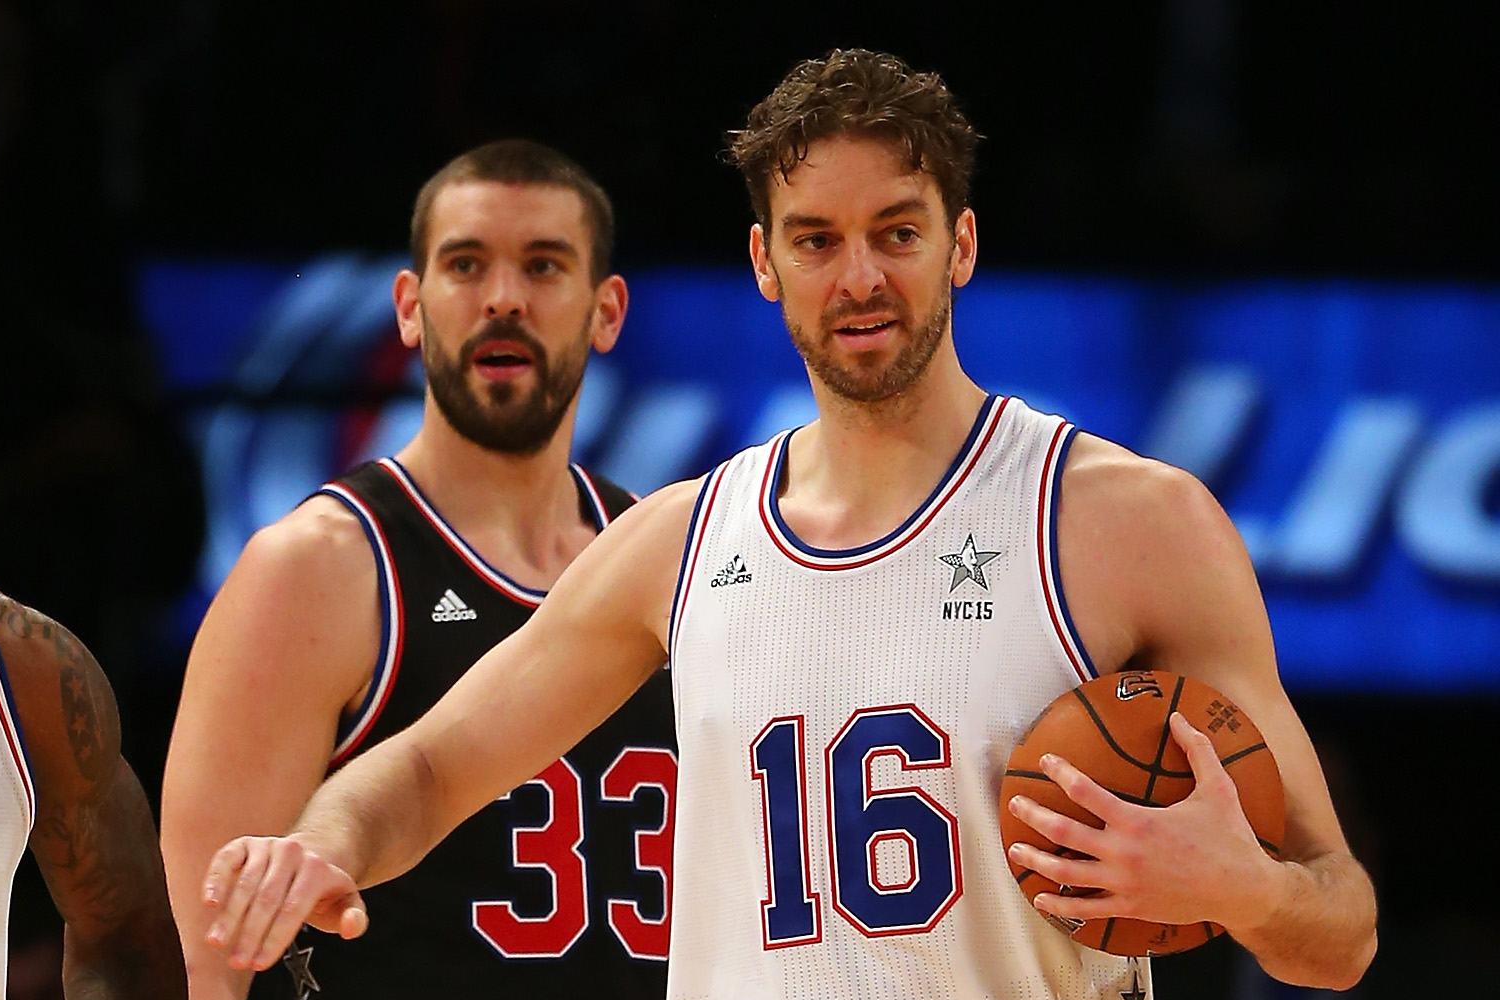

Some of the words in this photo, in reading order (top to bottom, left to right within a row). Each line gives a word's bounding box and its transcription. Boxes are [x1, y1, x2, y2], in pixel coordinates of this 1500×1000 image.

[431, 609, 477, 622] adidas
[471, 746, 679, 961] 33
[750, 703, 963, 950] 16
